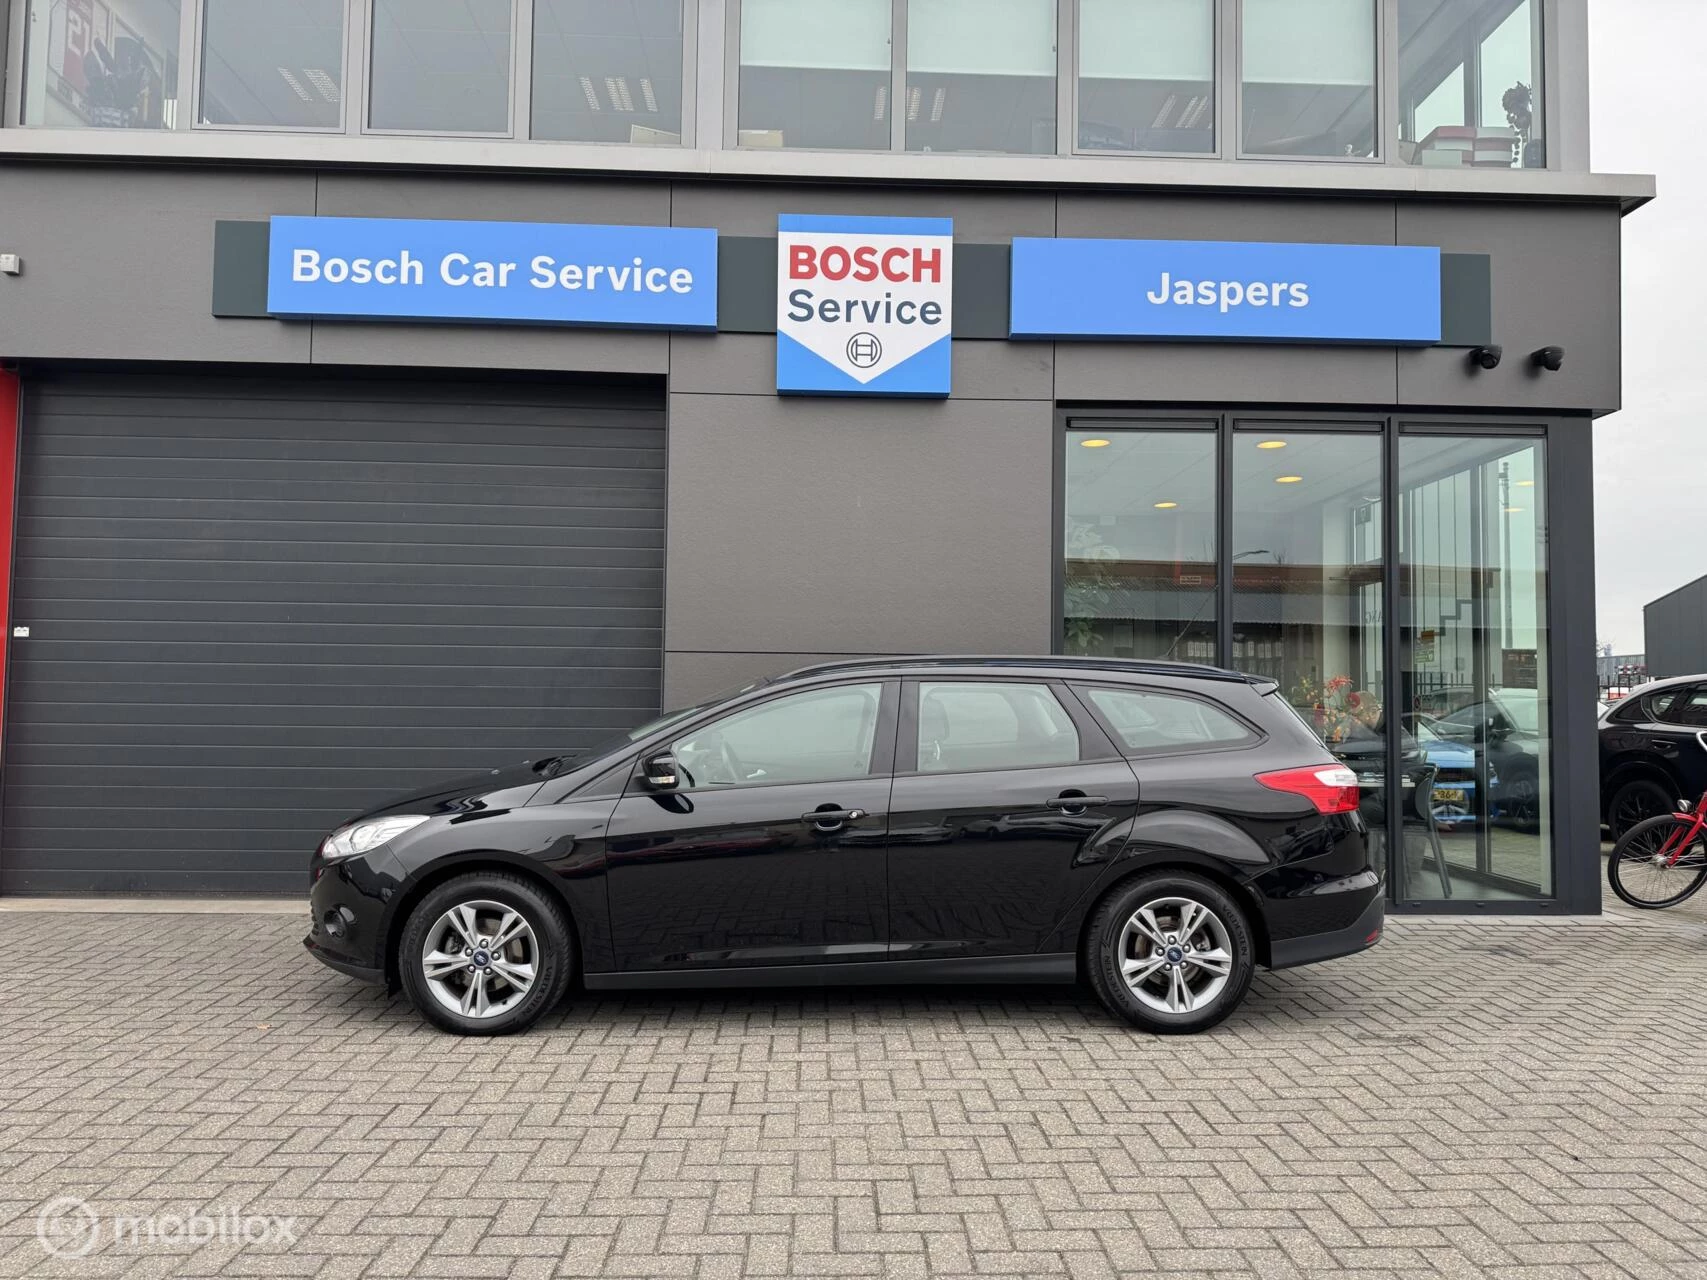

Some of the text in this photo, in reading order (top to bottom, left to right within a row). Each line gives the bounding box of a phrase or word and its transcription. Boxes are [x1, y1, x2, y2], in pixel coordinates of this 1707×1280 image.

[293, 249, 694, 295] Bosch Car Service
[789, 245, 942, 284] BOSCH
[787, 289, 943, 326] Service
[1147, 272, 1310, 313] Jaspers
